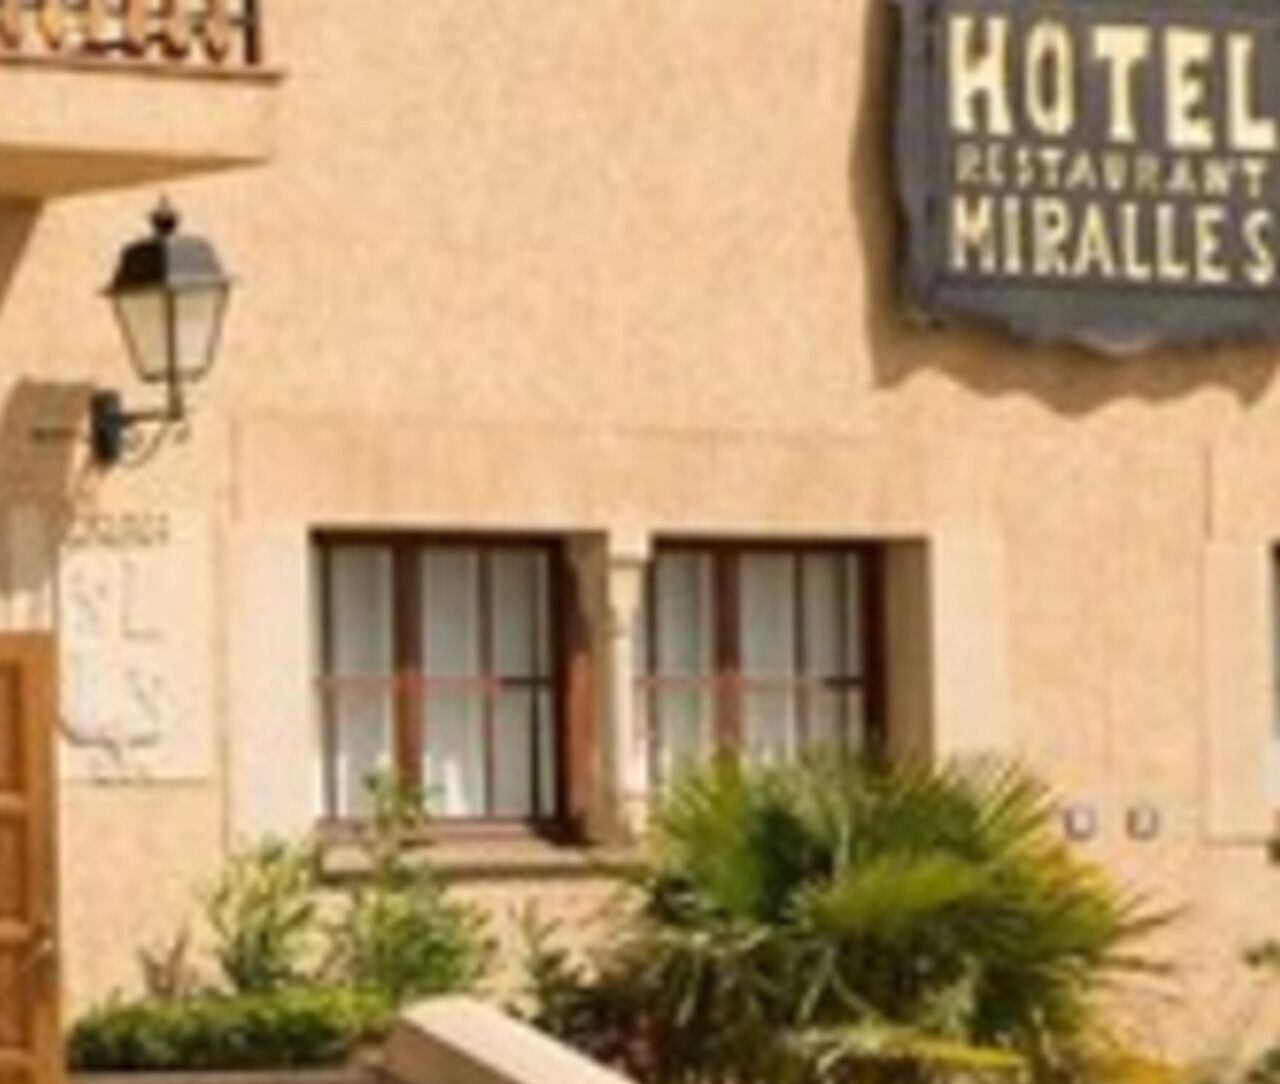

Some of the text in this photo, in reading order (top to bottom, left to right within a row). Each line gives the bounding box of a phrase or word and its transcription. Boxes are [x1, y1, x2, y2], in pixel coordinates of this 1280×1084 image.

[949, 15, 1278, 151] HOTEL
[953, 142, 1268, 198] RESTAURANT
[951, 194, 1277, 285] MIRALLES
